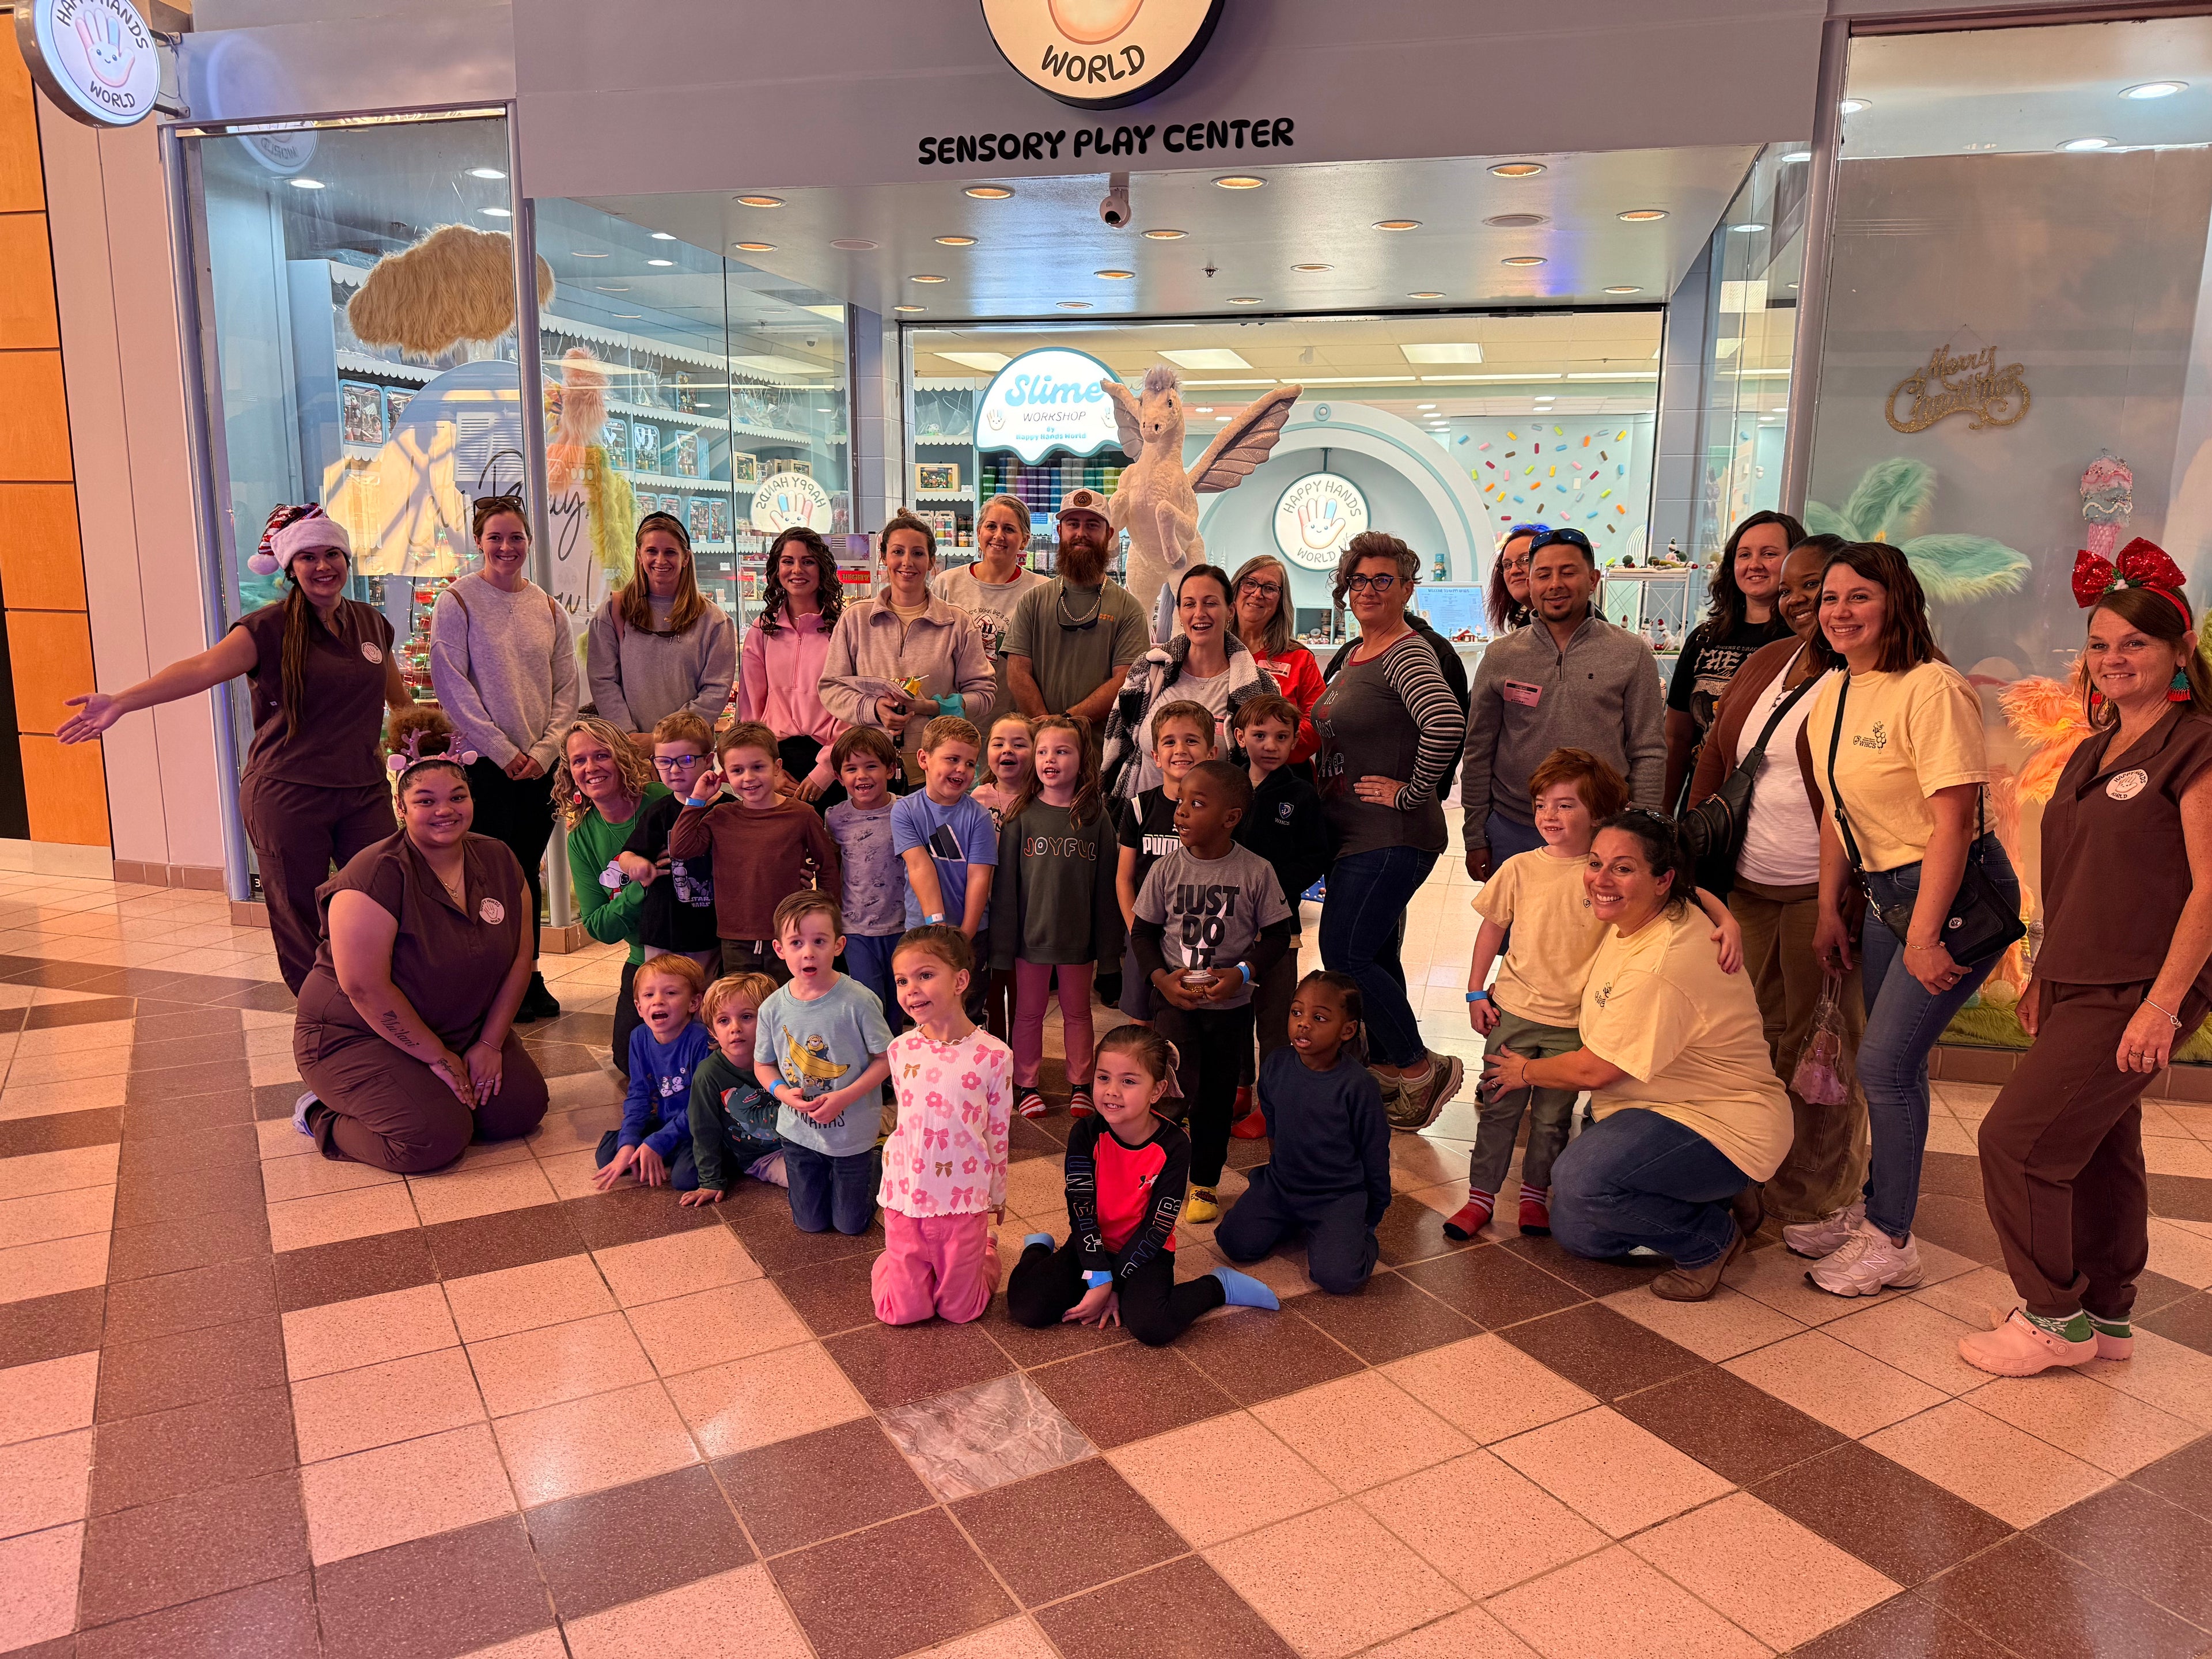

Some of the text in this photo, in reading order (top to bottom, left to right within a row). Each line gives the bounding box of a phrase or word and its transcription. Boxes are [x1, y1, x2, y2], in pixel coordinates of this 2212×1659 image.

[1041, 44, 1145, 84] WORLD
[90, 81, 135, 108] WORLD
[918, 117, 1294, 165] SENSORY PLAY CENTER
[1928, 344, 1997, 391] Merry
[1005, 374, 1105, 407] Slime
[1024, 411, 1086, 422] WORKSHOP
[1283, 480, 1361, 517] HAPPY HANDS
[1297, 547, 1336, 563] WORLD
[1859, 740, 1877, 749] WHCS
[1275, 817, 1290, 825] WHCS
[1024, 837, 1096, 861] JOYFUL
[1173, 884, 1240, 916] JUST
[1183, 915, 1225, 947] DO
